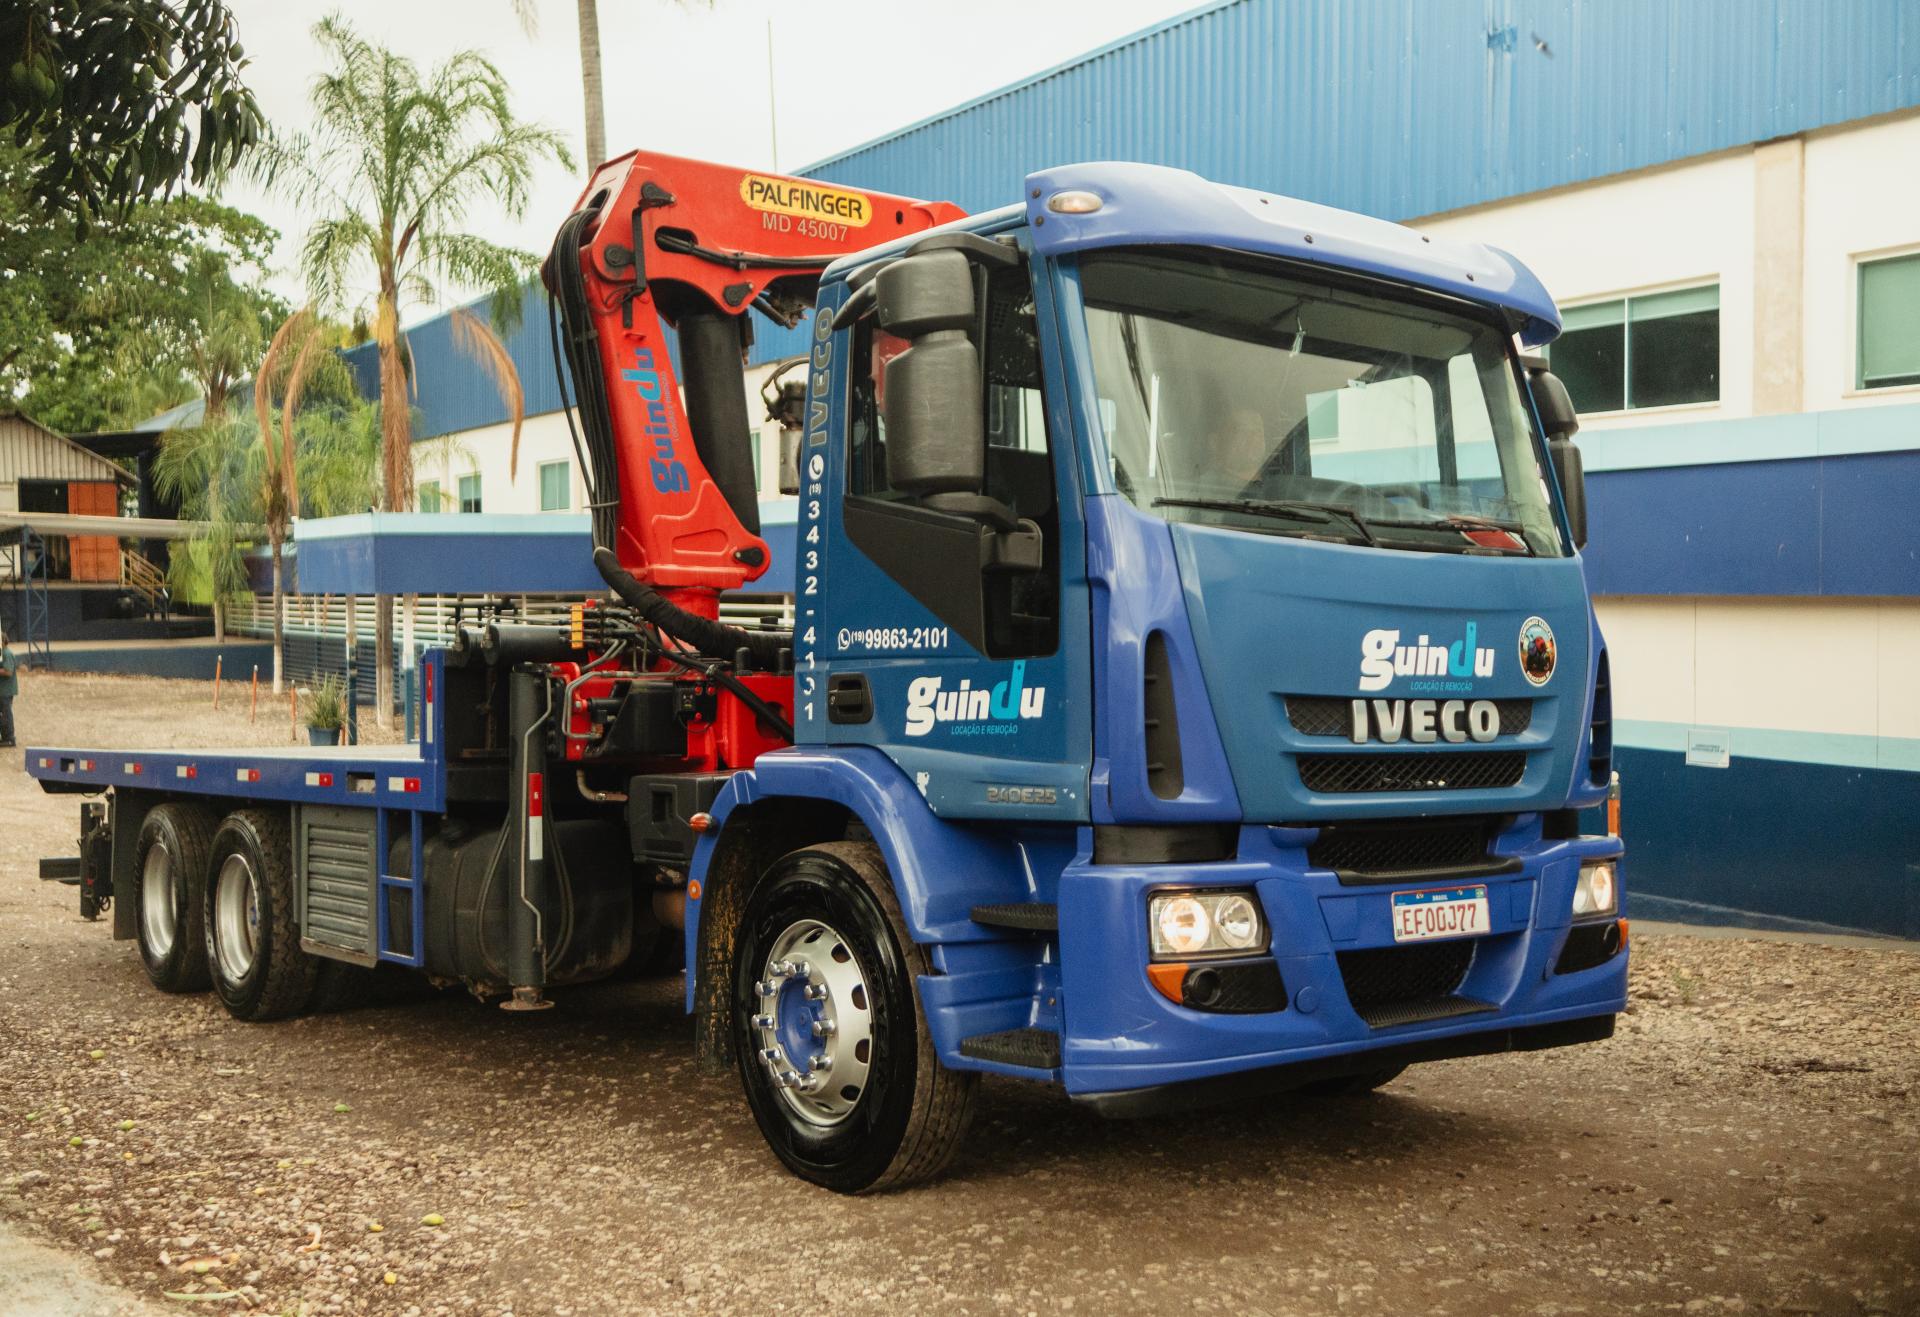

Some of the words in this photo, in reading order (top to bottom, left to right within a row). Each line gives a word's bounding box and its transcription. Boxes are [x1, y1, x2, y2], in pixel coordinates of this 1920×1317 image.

[749, 179, 863, 220] PALFINGER
[762, 211, 792, 233] MD
[796, 217, 848, 242] 45007
[809, 306, 835, 448] IVECO
[621, 347, 691, 494] guindu
[1358, 621, 1496, 692] guindu
[904, 659, 1046, 737] guindu
[951, 723, 981, 737] LOCAÇÃO
[981, 725, 986, 735] E
[986, 722, 1018, 736] REMOÇÃO
[1351, 699, 1500, 744] IVECO
[986, 787, 1057, 804] 240E25
